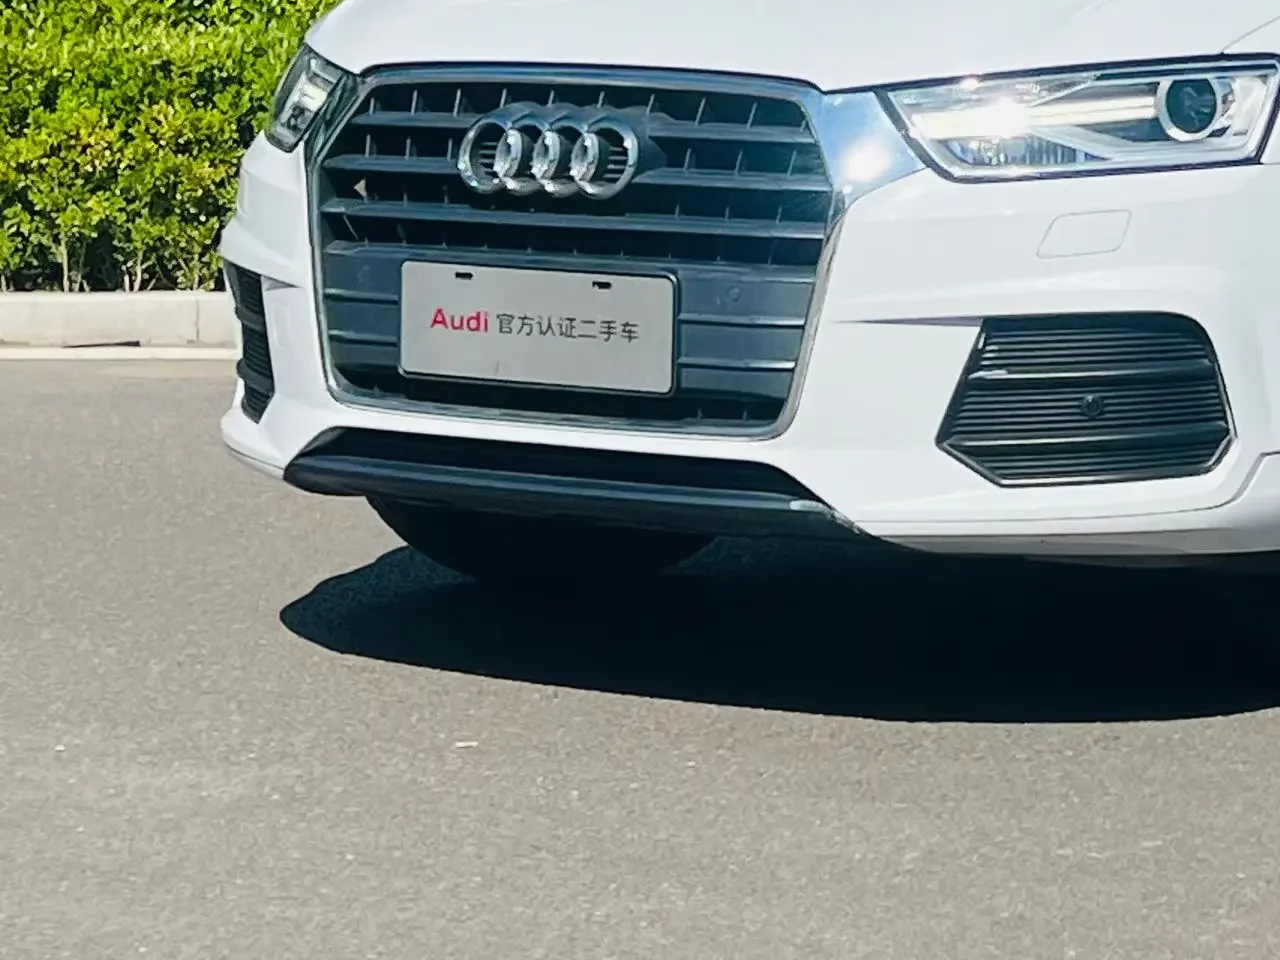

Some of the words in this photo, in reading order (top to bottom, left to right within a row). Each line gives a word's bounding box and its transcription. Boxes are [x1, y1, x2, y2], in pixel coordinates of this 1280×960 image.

[430, 307, 488, 333] Audi
[496, 313, 639, 343] 官方认证二手车
